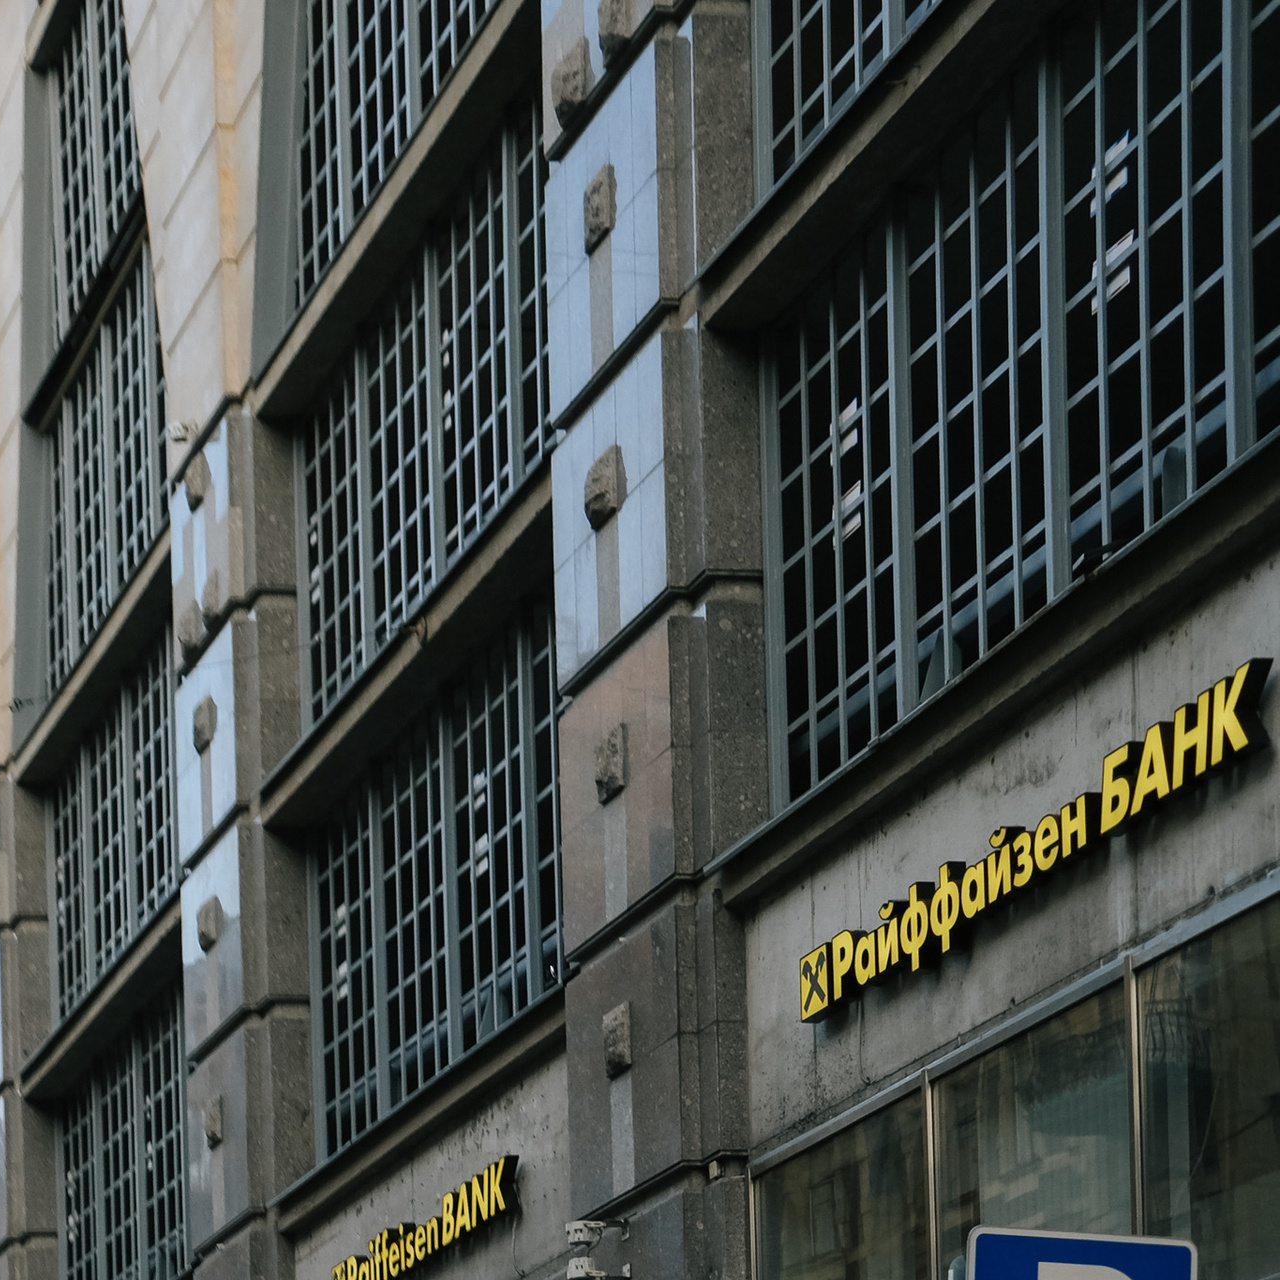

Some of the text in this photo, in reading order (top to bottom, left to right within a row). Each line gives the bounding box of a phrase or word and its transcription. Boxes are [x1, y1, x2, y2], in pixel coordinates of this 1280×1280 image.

[831, 658, 1254, 1001] Райффайзен БАНК
[441, 1156, 507, 1247] BANK
